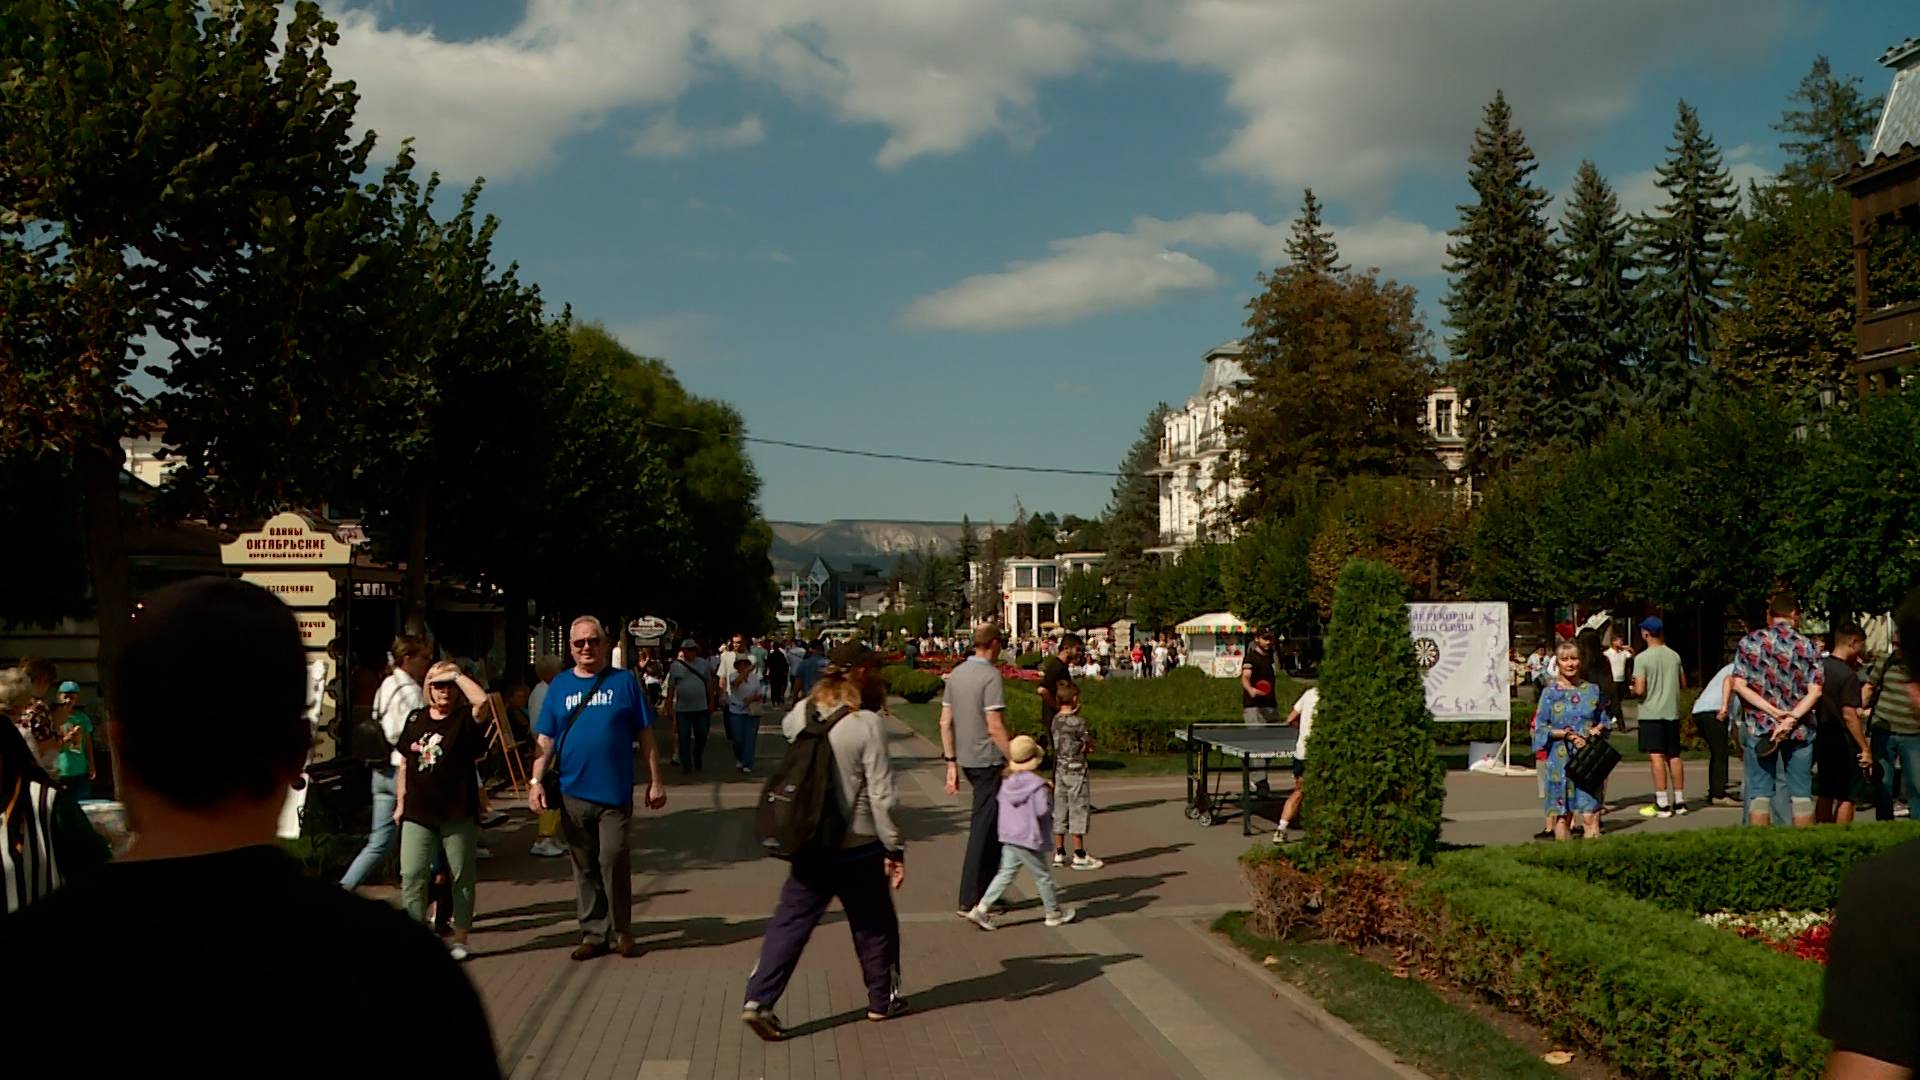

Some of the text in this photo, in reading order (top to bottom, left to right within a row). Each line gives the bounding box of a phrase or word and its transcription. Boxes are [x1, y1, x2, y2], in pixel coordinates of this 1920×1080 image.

[269, 527, 303, 536] ВАННЫ
[246, 539, 326, 550] ОКТЯБРЬСКИЕ
[565, 689, 614, 711] got ata?
